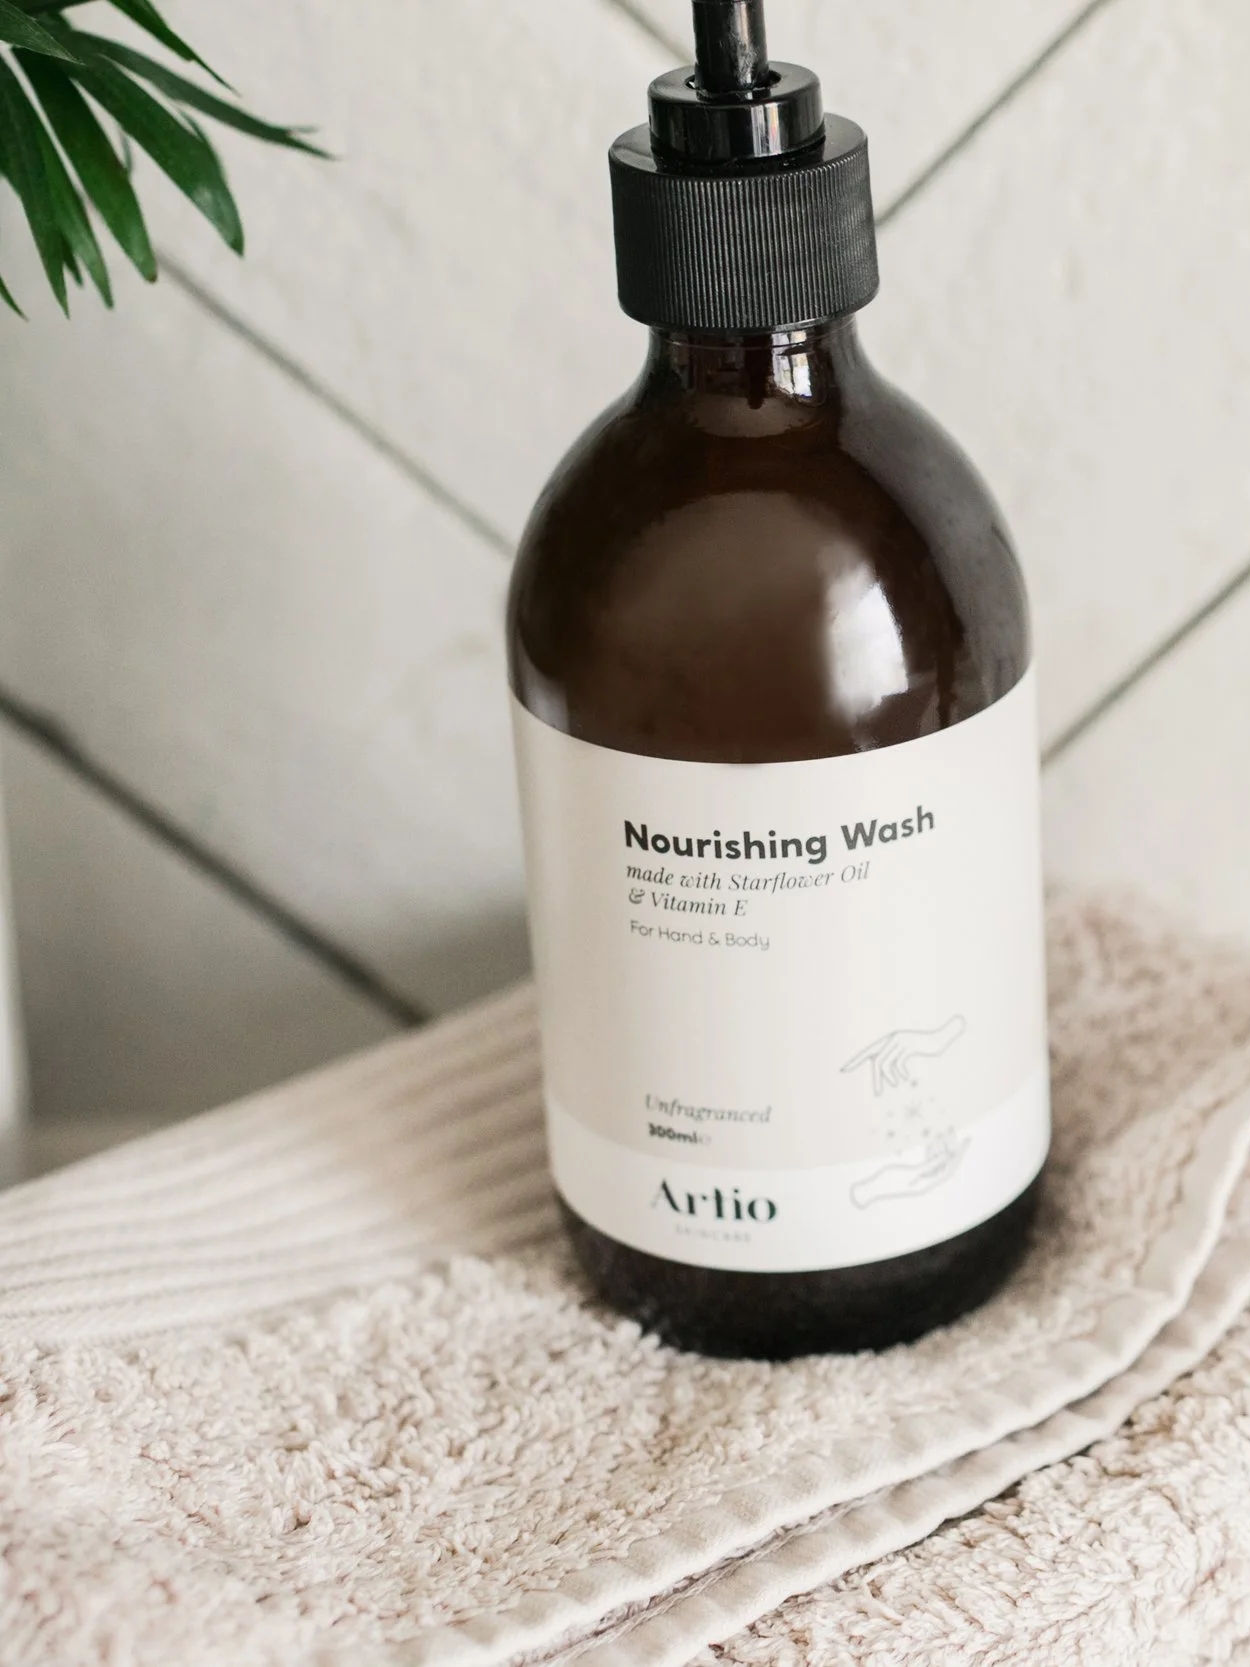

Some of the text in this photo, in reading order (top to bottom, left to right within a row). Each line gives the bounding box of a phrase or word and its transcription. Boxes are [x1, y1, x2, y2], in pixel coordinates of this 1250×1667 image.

[623, 805, 935, 865] Nourishing Wash
[626, 861, 870, 894] made with Starflower Oil
[628, 888, 749, 917] & Vitamin E
[630, 920, 770, 950] For Hand & Body
[645, 1094, 772, 1123] Unfragranced
[651, 1178, 777, 1222] Artio
